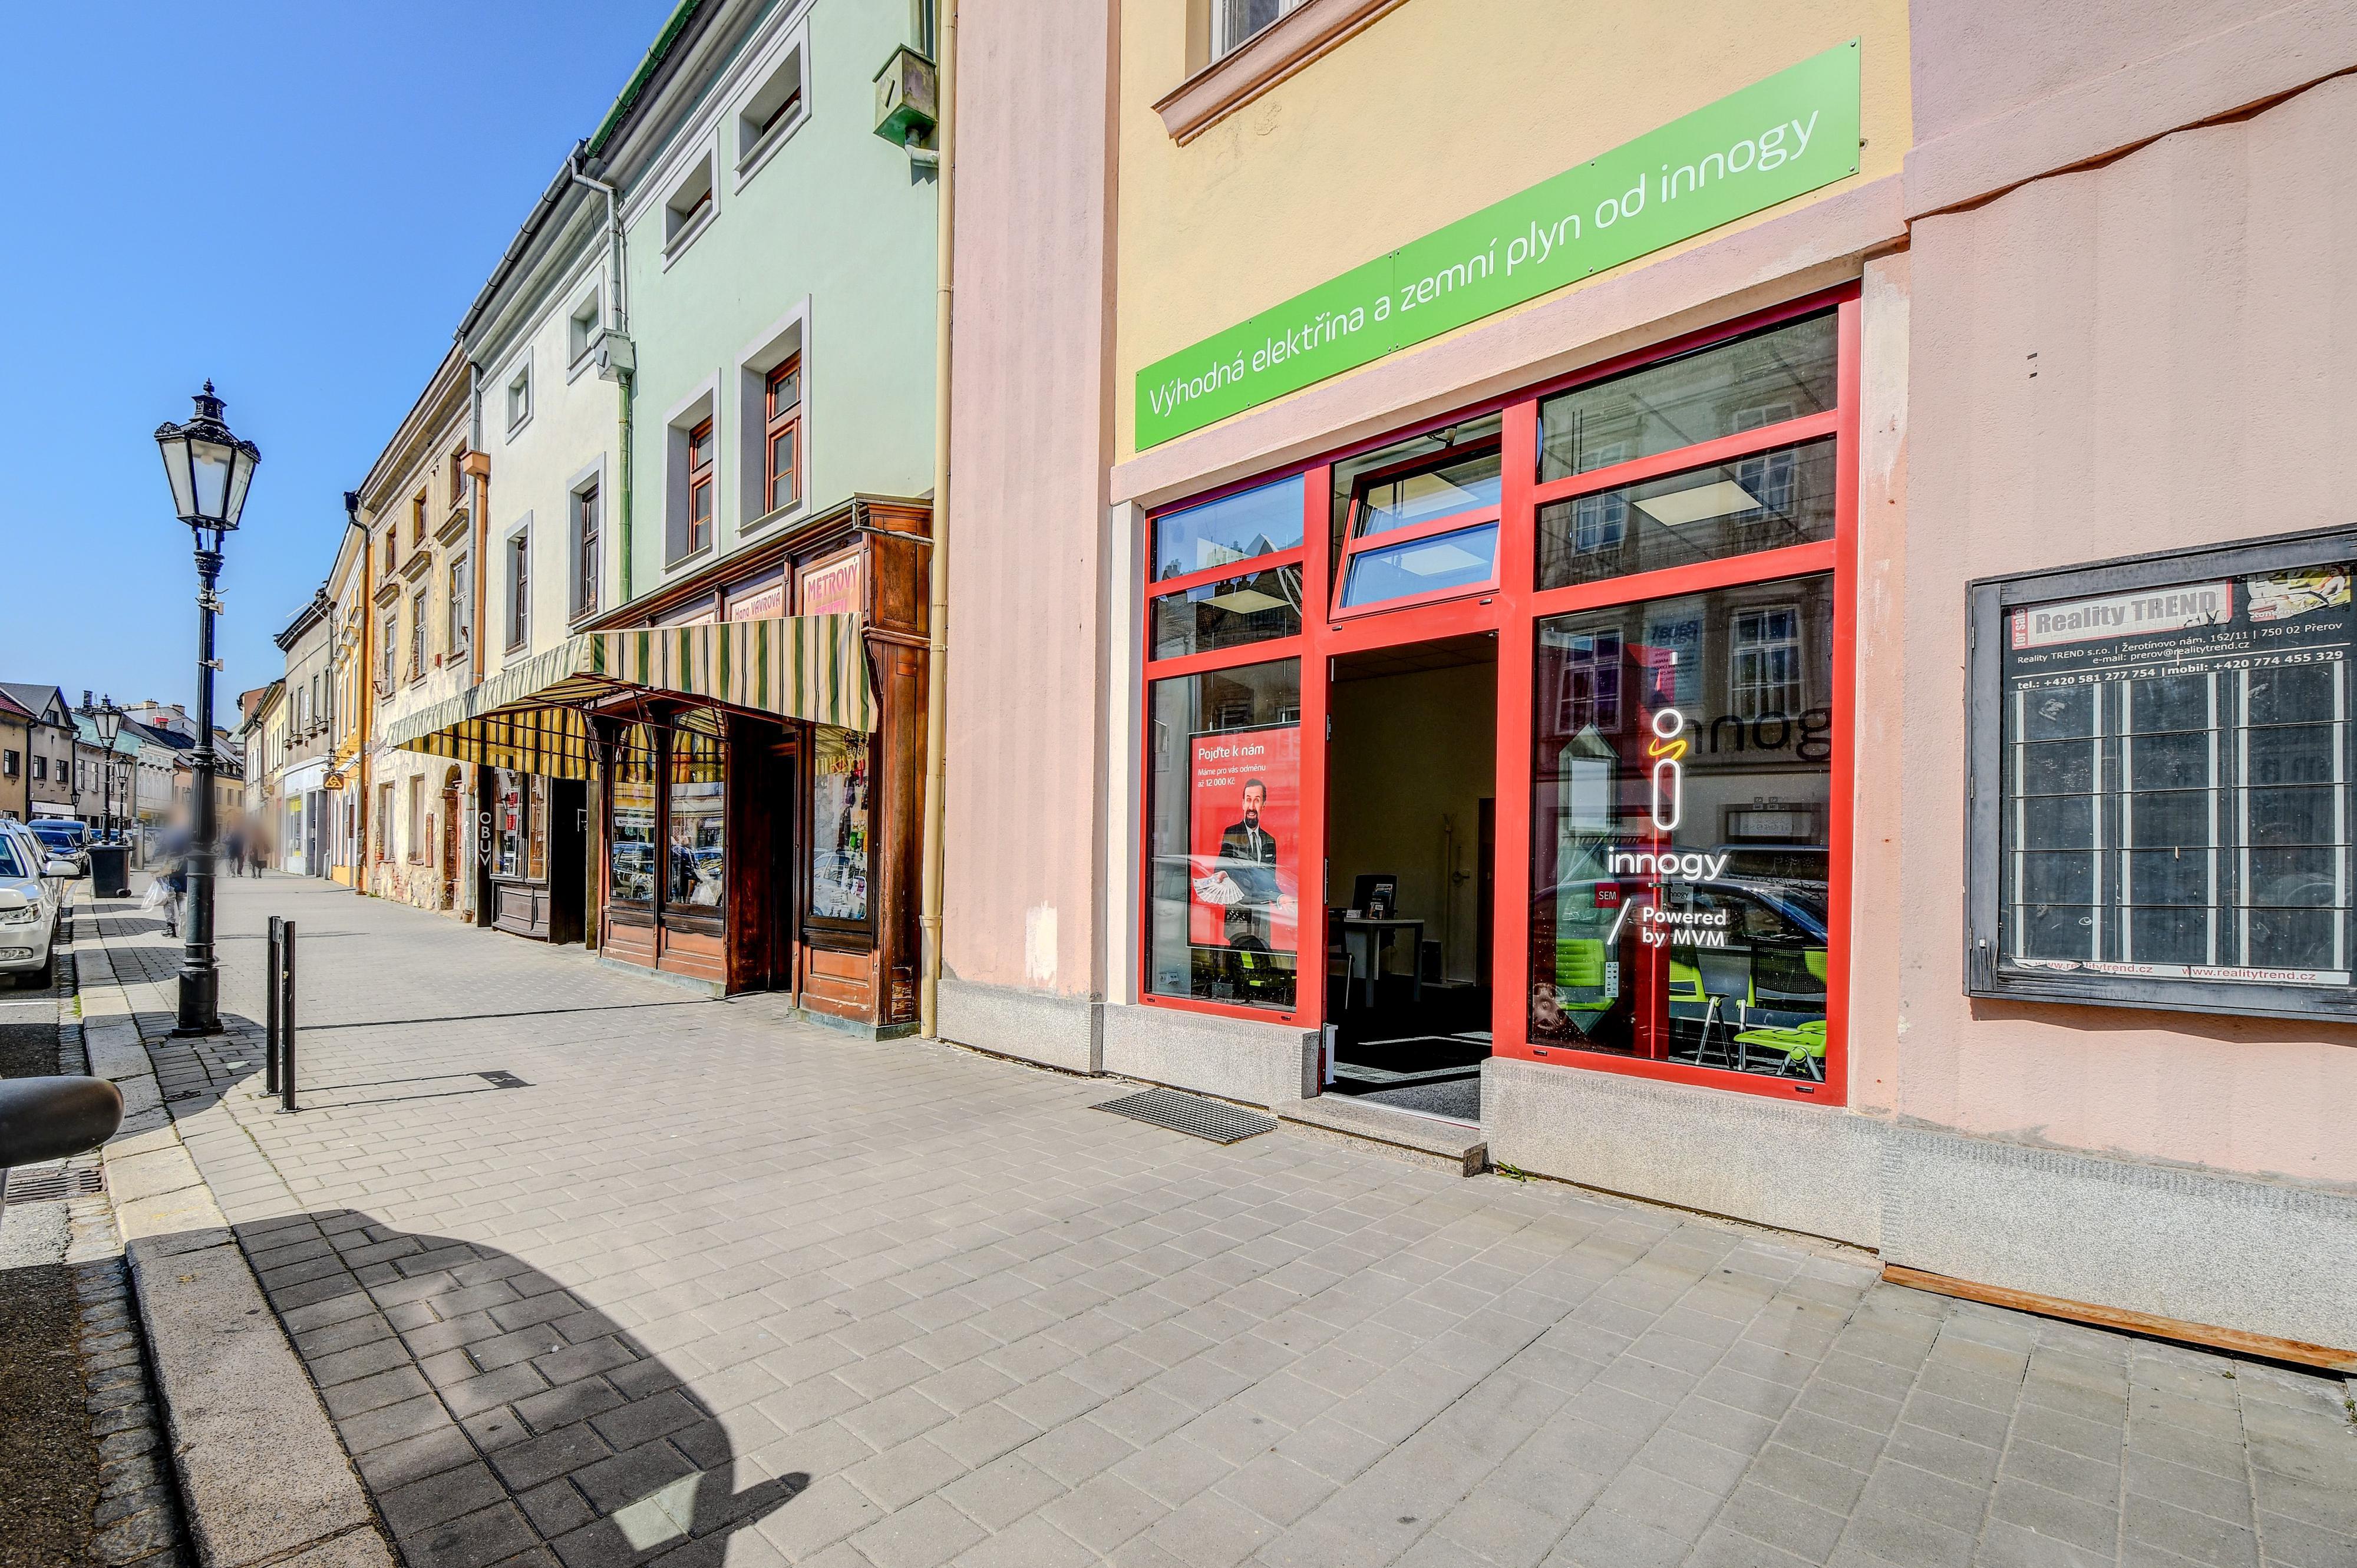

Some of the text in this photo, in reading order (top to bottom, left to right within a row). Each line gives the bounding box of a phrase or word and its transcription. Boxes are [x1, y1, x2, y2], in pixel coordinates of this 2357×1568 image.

[1149, 110, 1819, 417] Výhodná elektřina a zemní plyn od innogy
[808, 557, 858, 602] METROVÝ
[735, 607, 749, 620] Hana
[751, 588, 780, 615] VÁVROVÁ
[2036, 591, 2216, 633] Reality TREND
[2013, 608, 2026, 647] for sale
[2018, 654, 2048, 663] Reality
[2051, 650, 2084, 659] TREND
[2122, 640, 2176, 652] Žerotínovo
[2180, 637, 2206, 646] nám.
[2210, 631, 2247, 643] 162/11
[2261, 628, 2282, 637] 750
[2286, 626, 2300, 634] 02
[2305, 623, 2342, 632] Přerov
[2092, 641, 2250, 664] e-mail: prerov@realitytrend.cz
[2018, 651, 2343, 689] tel.: +420 581 277 754 mobil: +420 774 455 329
[1683, 707, 1831, 761] nnog
[1199, 743, 1264, 762] Pojďte k nám
[1198, 780, 1204, 788] až
[1214, 778, 1226, 786] 000
[1217, 768, 1227, 776] pro
[1228, 765, 1238, 774] vás
[1240, 764, 1266, 773] odměnu
[479, 812, 491, 866] OBUV
[1608, 846, 1728, 881] innogy
[1598, 890, 1616, 900] SEM
[1643, 907, 1727, 926] Powered
[1642, 927, 1725, 948] by MVM
[2035, 961, 2153, 973] ww.relitytrend.cz
[2182, 968, 2316, 981] www.realitytrend.cz
